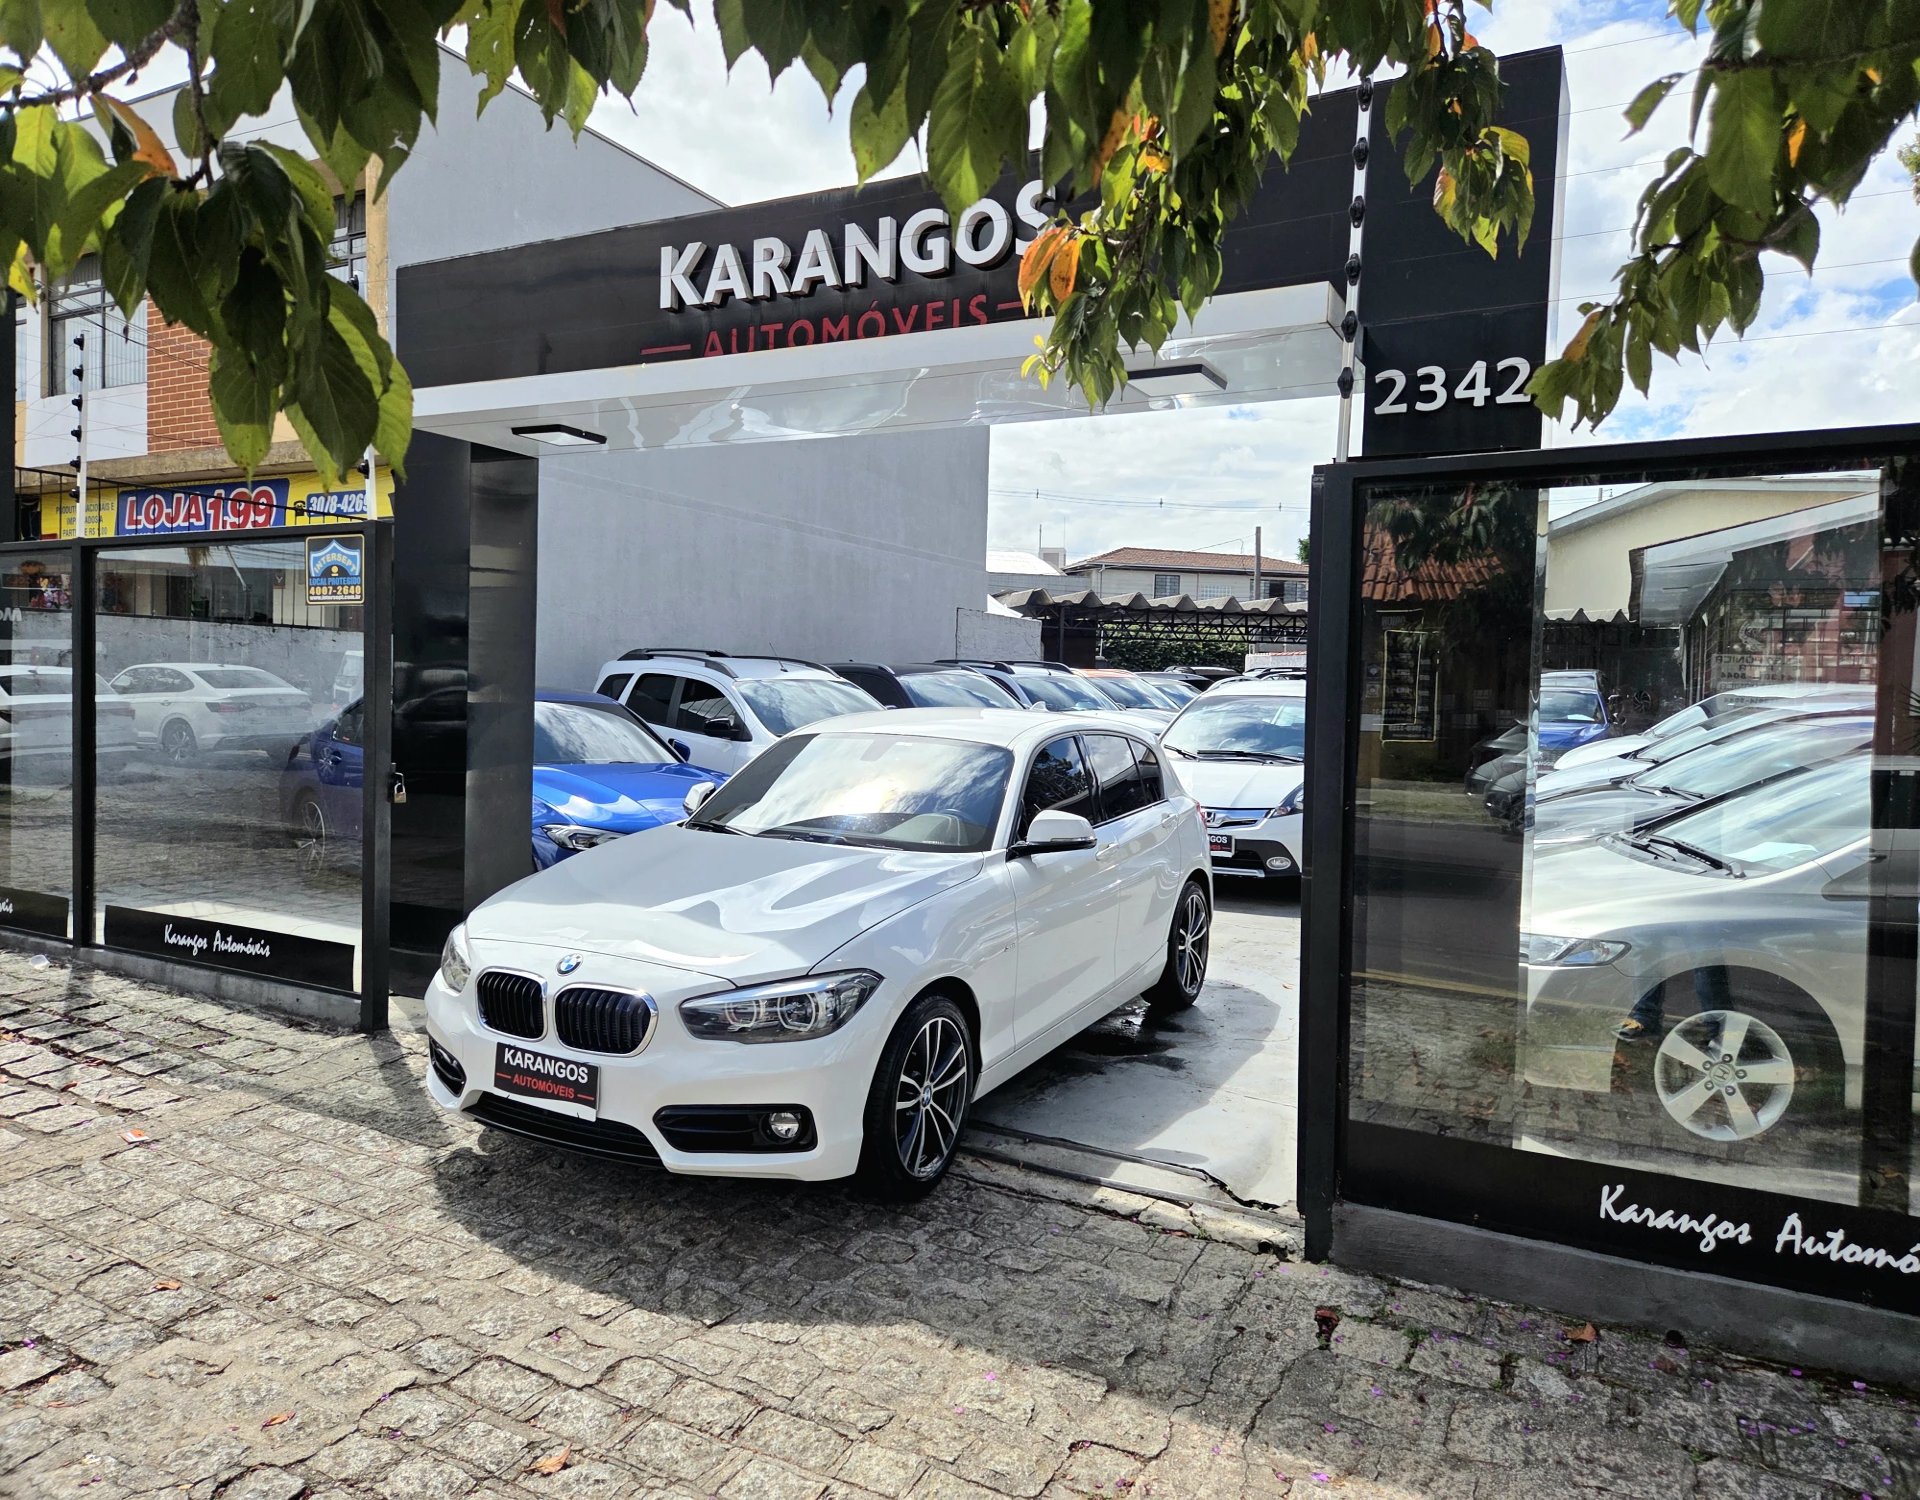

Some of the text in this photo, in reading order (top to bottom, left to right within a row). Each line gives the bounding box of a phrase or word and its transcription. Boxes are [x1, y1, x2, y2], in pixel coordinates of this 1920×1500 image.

[659, 179, 1056, 313] KARANGOS
[1374, 356, 1532, 415] 2342
[125, 491, 205, 530] LOJA
[313, 552, 357, 573] INTERSEPT
[309, 576, 361, 586] LOCAL PROTEGIDO
[309, 585, 362, 596] 4007-2640
[164, 923, 271, 958] Karangos Automóveis
[504, 1047, 589, 1084] KARANGOS
[512, 1073, 575, 1099] AUTOMÓVEIS
[1600, 1184, 1752, 1253] Karangos
